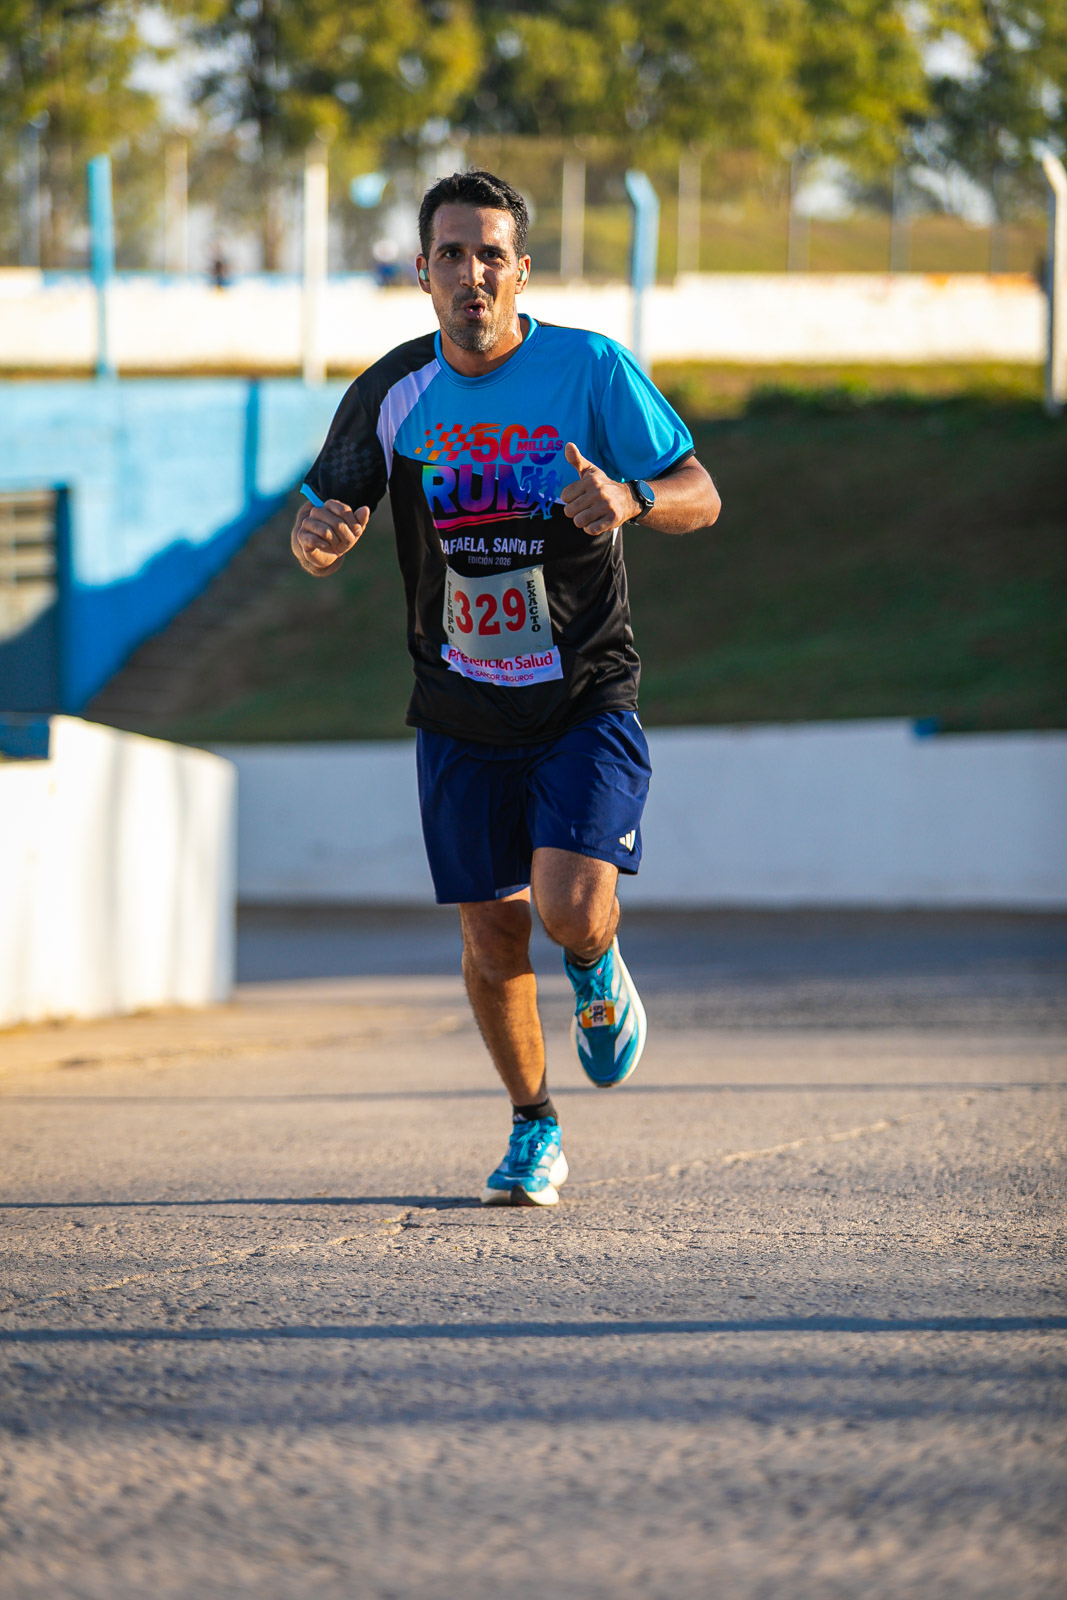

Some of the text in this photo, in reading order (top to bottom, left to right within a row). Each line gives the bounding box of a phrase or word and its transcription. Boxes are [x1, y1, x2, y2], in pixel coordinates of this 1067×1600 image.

[470, 423, 560, 465] 500
[517, 440, 563, 452] MILLAS
[422, 464, 535, 514] RUN
[493, 538, 527, 556] SANTA
[529, 540, 545, 555] FE
[468, 555, 512, 567] EDICIÓN 2026
[454, 587, 527, 636] 329
[526, 579, 541, 633] EXACTO
[515, 651, 553, 670] Salud
[501, 673, 534, 682] SEGUROS
